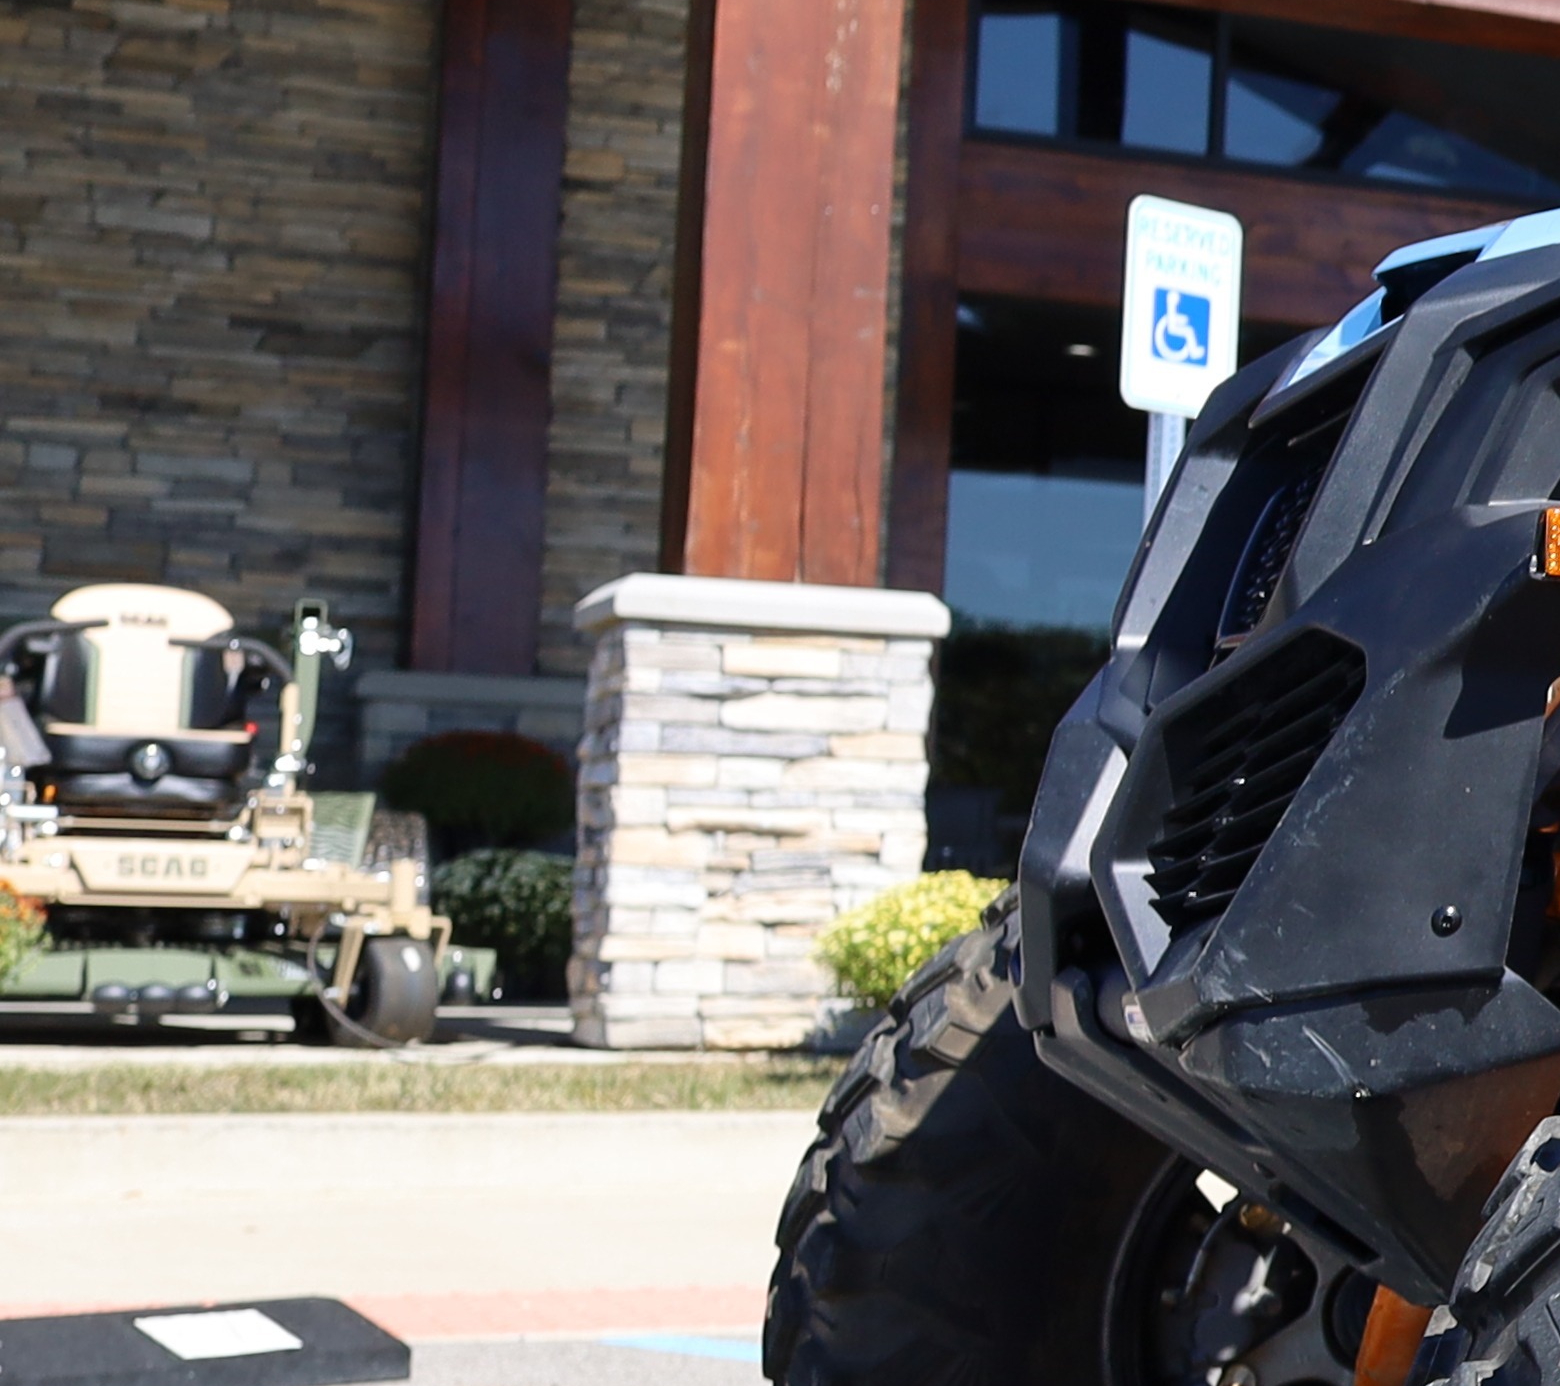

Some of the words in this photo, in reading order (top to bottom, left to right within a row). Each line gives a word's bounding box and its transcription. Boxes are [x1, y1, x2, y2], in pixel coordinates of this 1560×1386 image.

[1139, 215, 1230, 256] RESERVED
[1145, 248, 1222, 287] PARKING
[117, 855, 208, 879] SCAG
